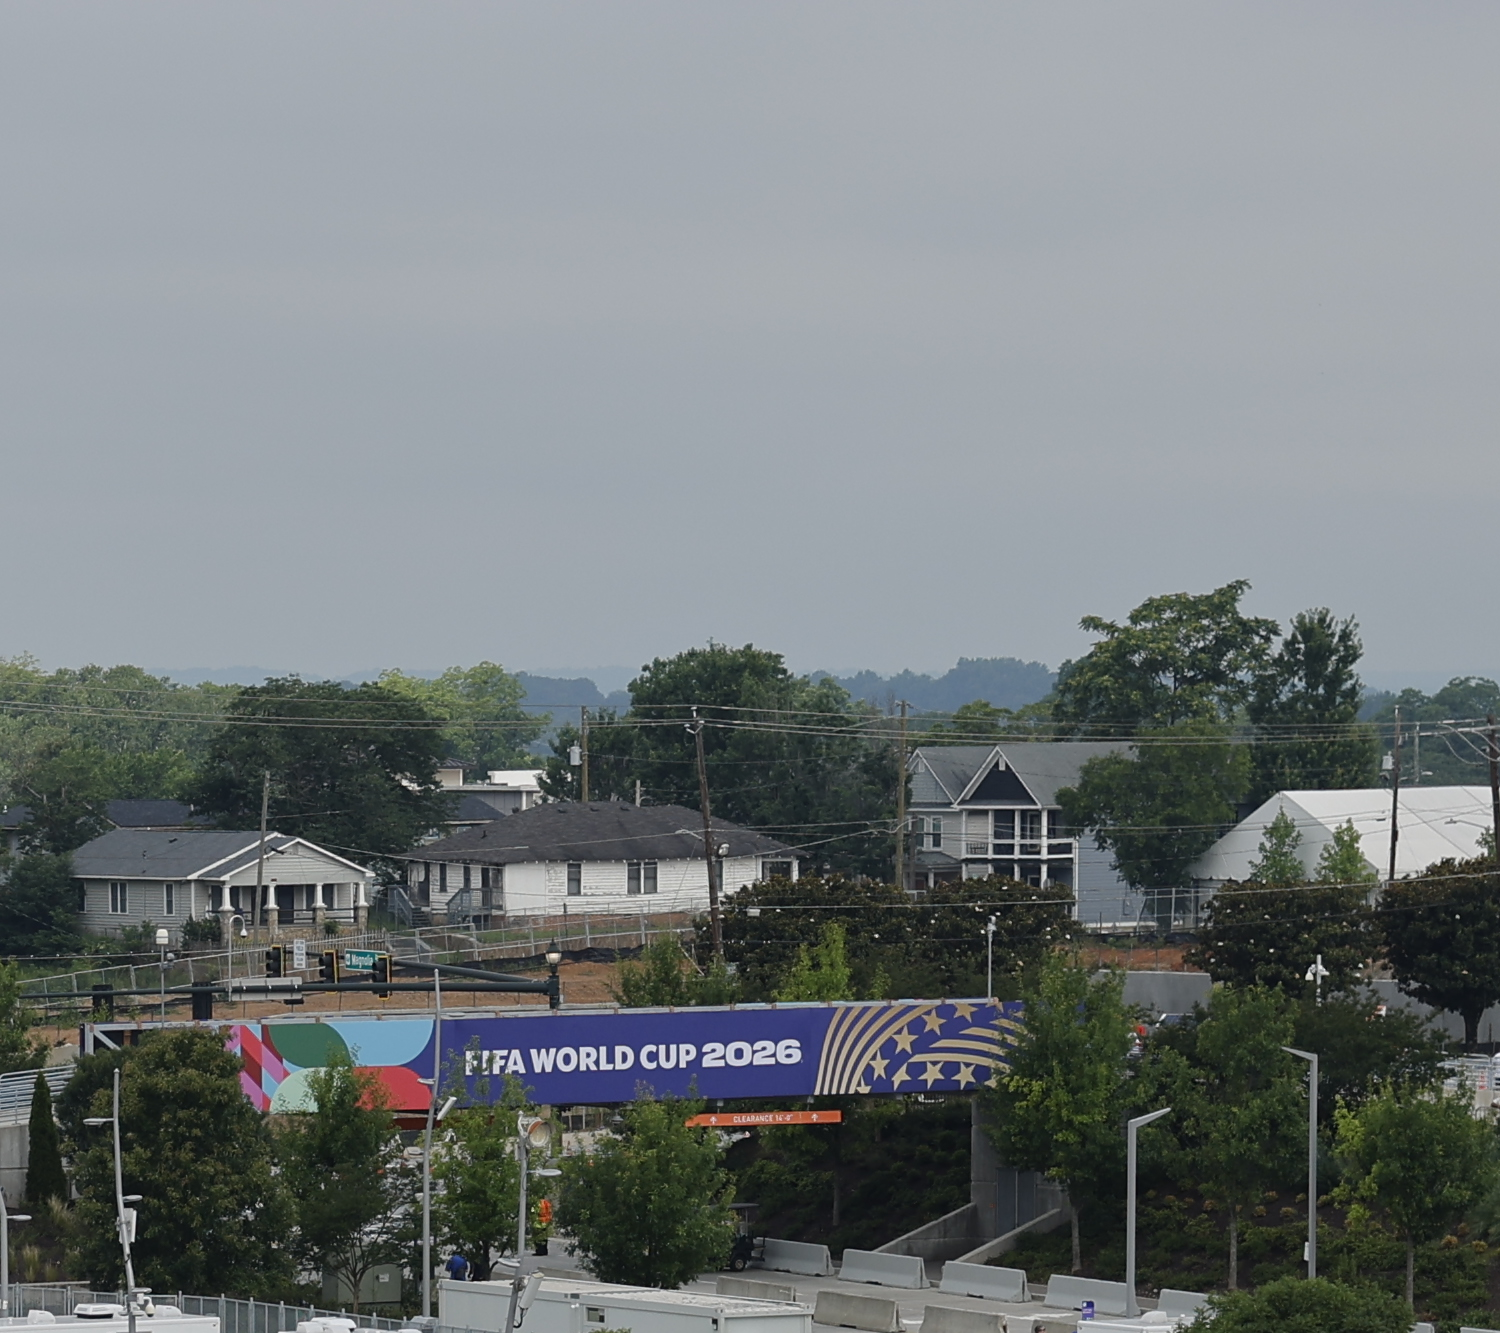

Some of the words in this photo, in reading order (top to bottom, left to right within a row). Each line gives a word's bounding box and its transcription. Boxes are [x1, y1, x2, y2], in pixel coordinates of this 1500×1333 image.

[465, 1048, 526, 1076] FIFA
[529, 1044, 635, 1074] WORLD
[640, 1042, 697, 1070] CUP
[701, 1038, 801, 1068] 2026
[733, 1114, 773, 1123] CLEARANCE
